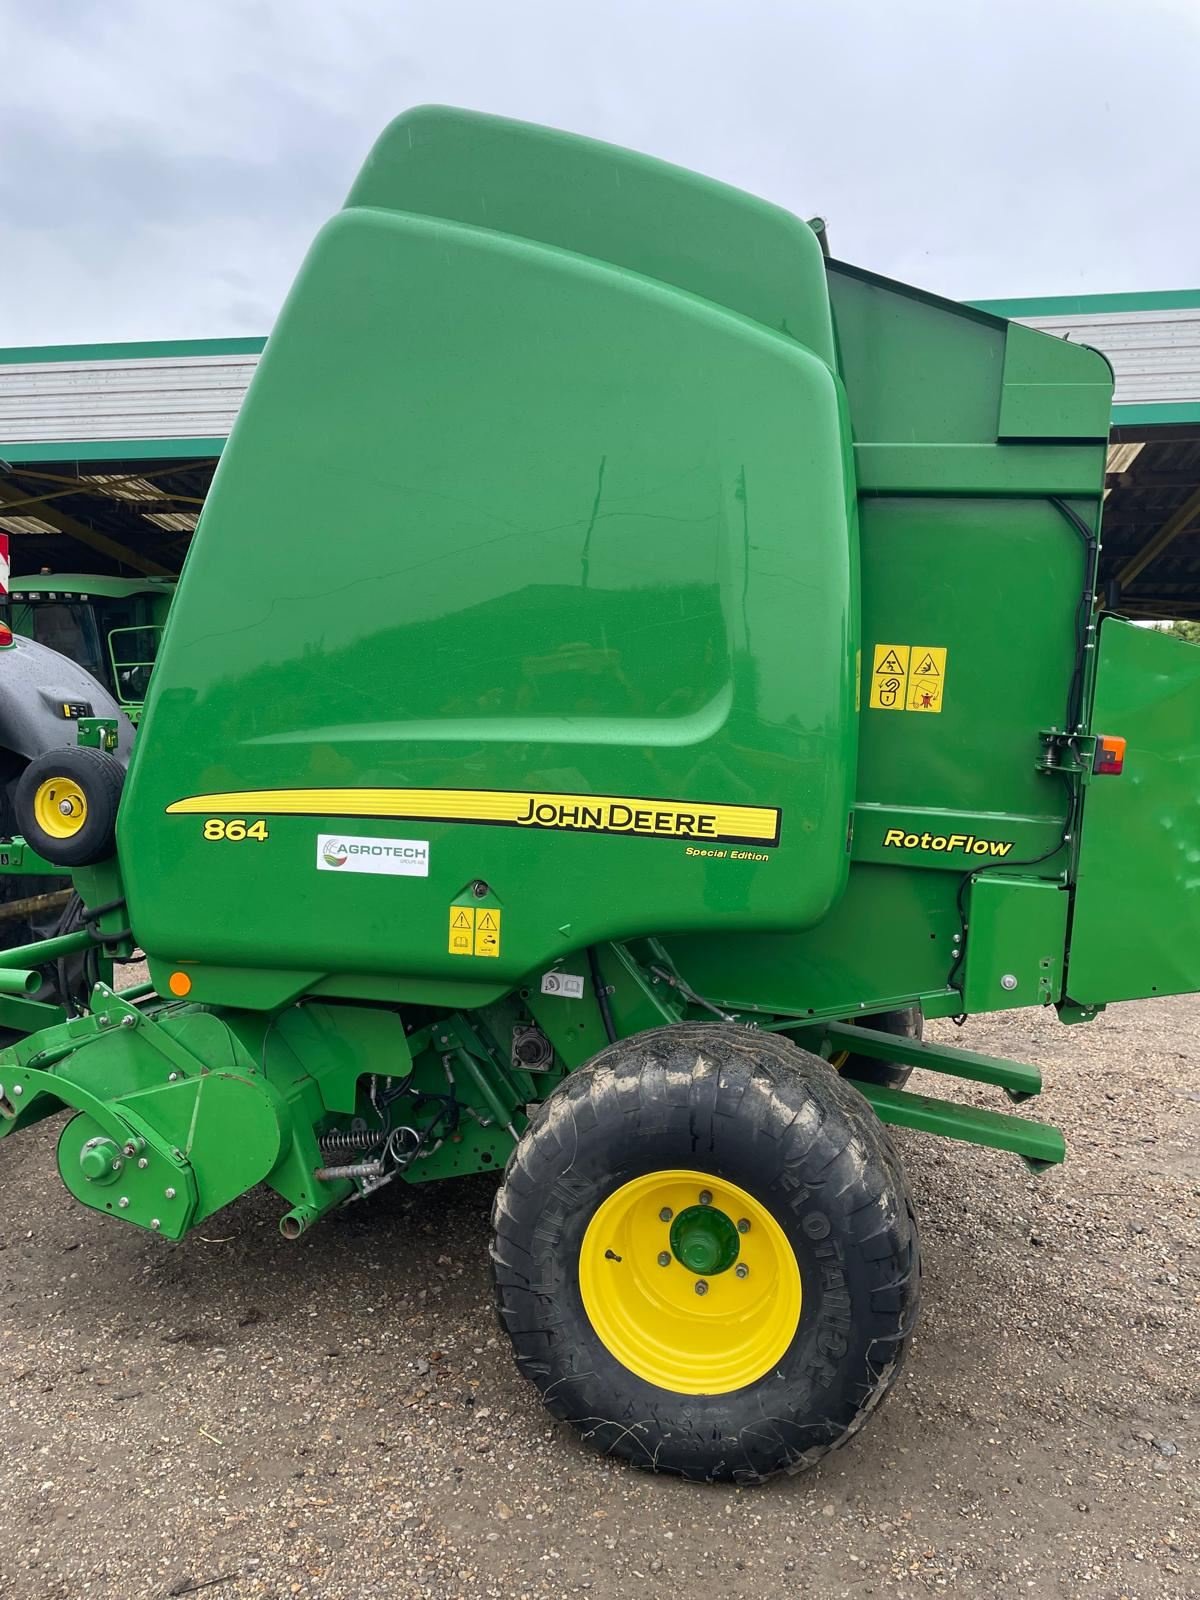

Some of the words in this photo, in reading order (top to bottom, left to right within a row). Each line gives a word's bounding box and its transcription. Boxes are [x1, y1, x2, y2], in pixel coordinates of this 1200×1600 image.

[517, 799, 602, 826] JOHN
[608, 804, 716, 834] DEERE
[203, 818, 269, 842] 864
[337, 843, 426, 858] AGROTECH
[685, 846, 727, 860] Special
[730, 850, 769, 863] Edition
[882, 828, 1014, 857] RotoFlow
